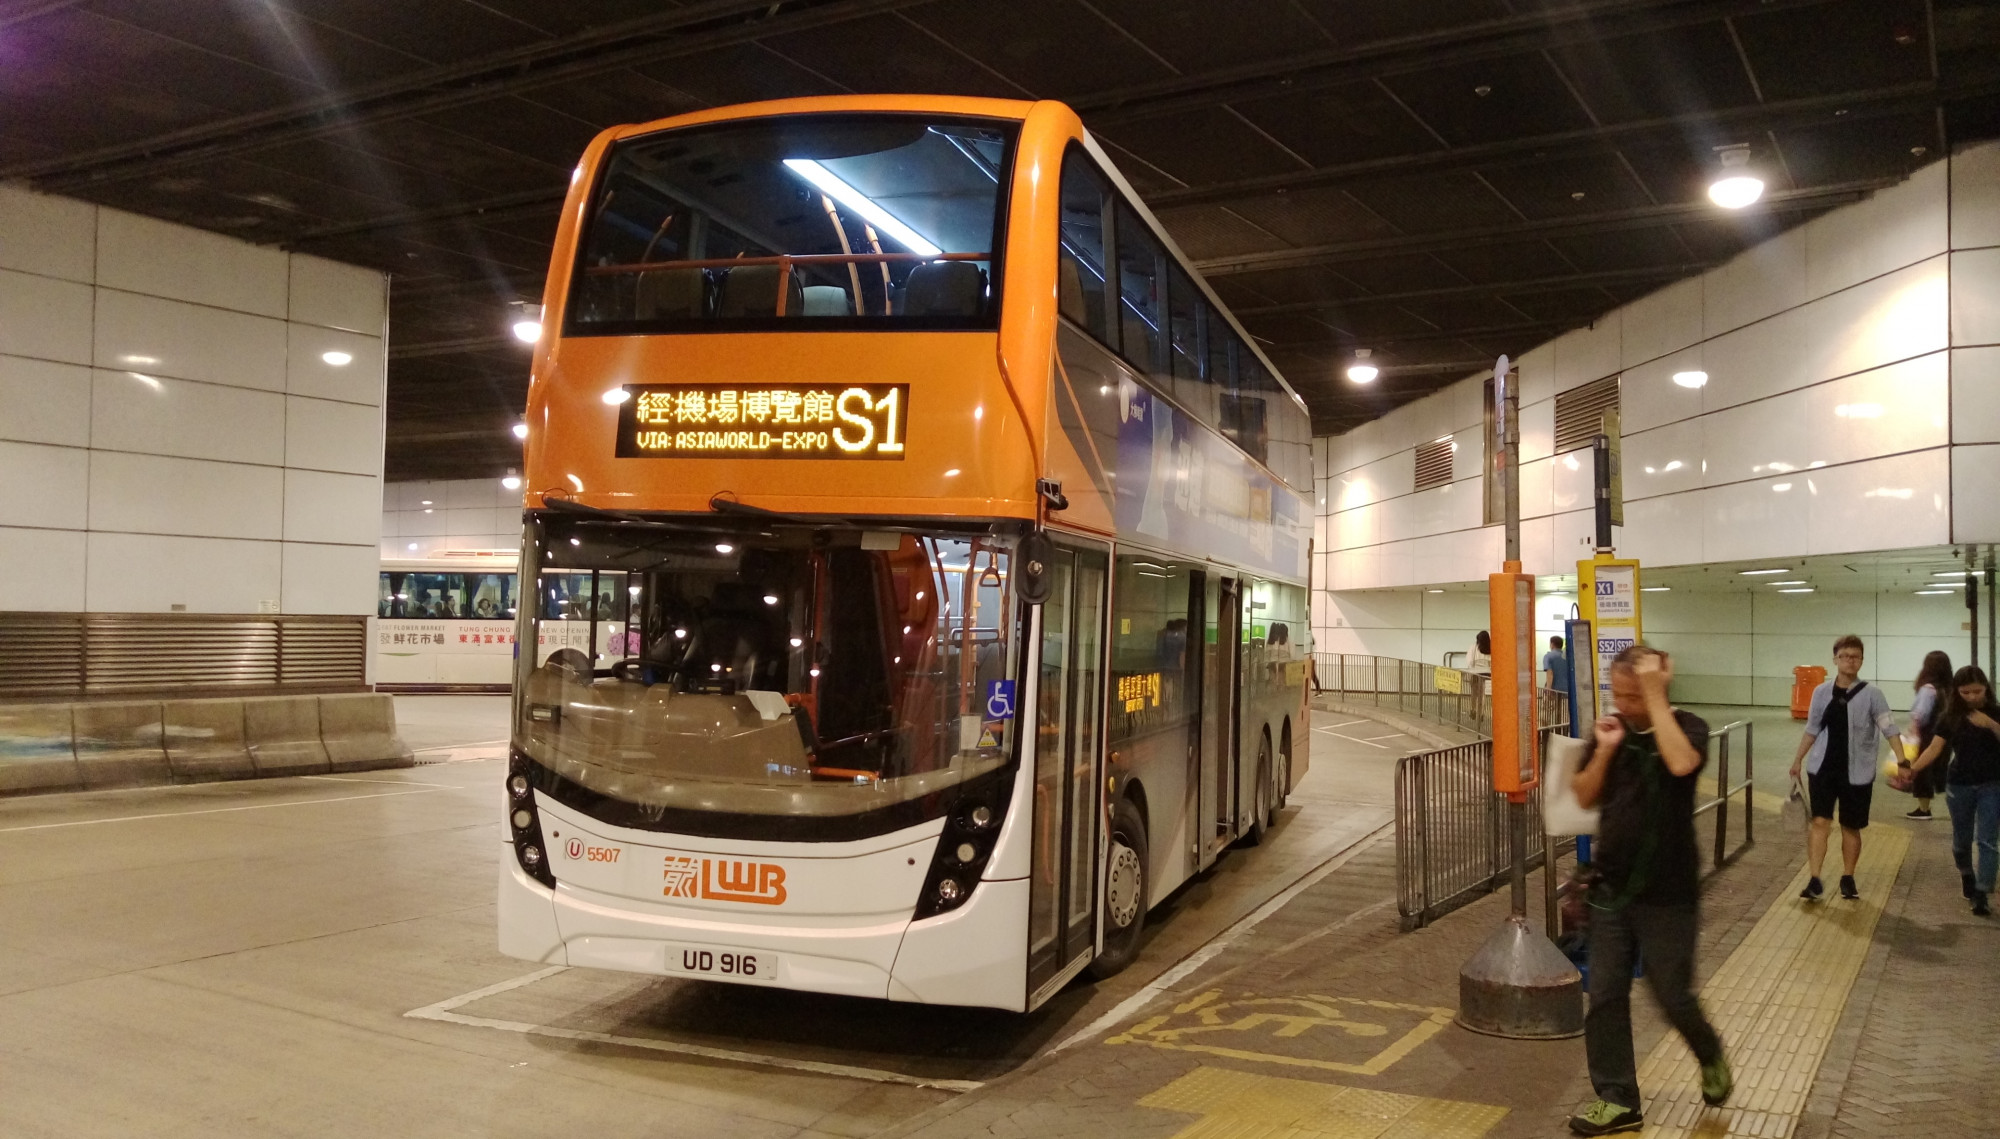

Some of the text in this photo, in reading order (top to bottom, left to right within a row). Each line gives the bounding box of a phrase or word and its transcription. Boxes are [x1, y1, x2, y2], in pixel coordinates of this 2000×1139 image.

[833, 387, 904, 452] S1
[637, 432, 828, 449] VIA: ASIAWORLD-EXPO
[1597, 583, 1612, 595] X1
[1598, 640, 1615, 652] S52
[587, 847, 621, 863] 5507
[702, 859, 787, 906] LWB
[684, 950, 757, 975] UD 916
